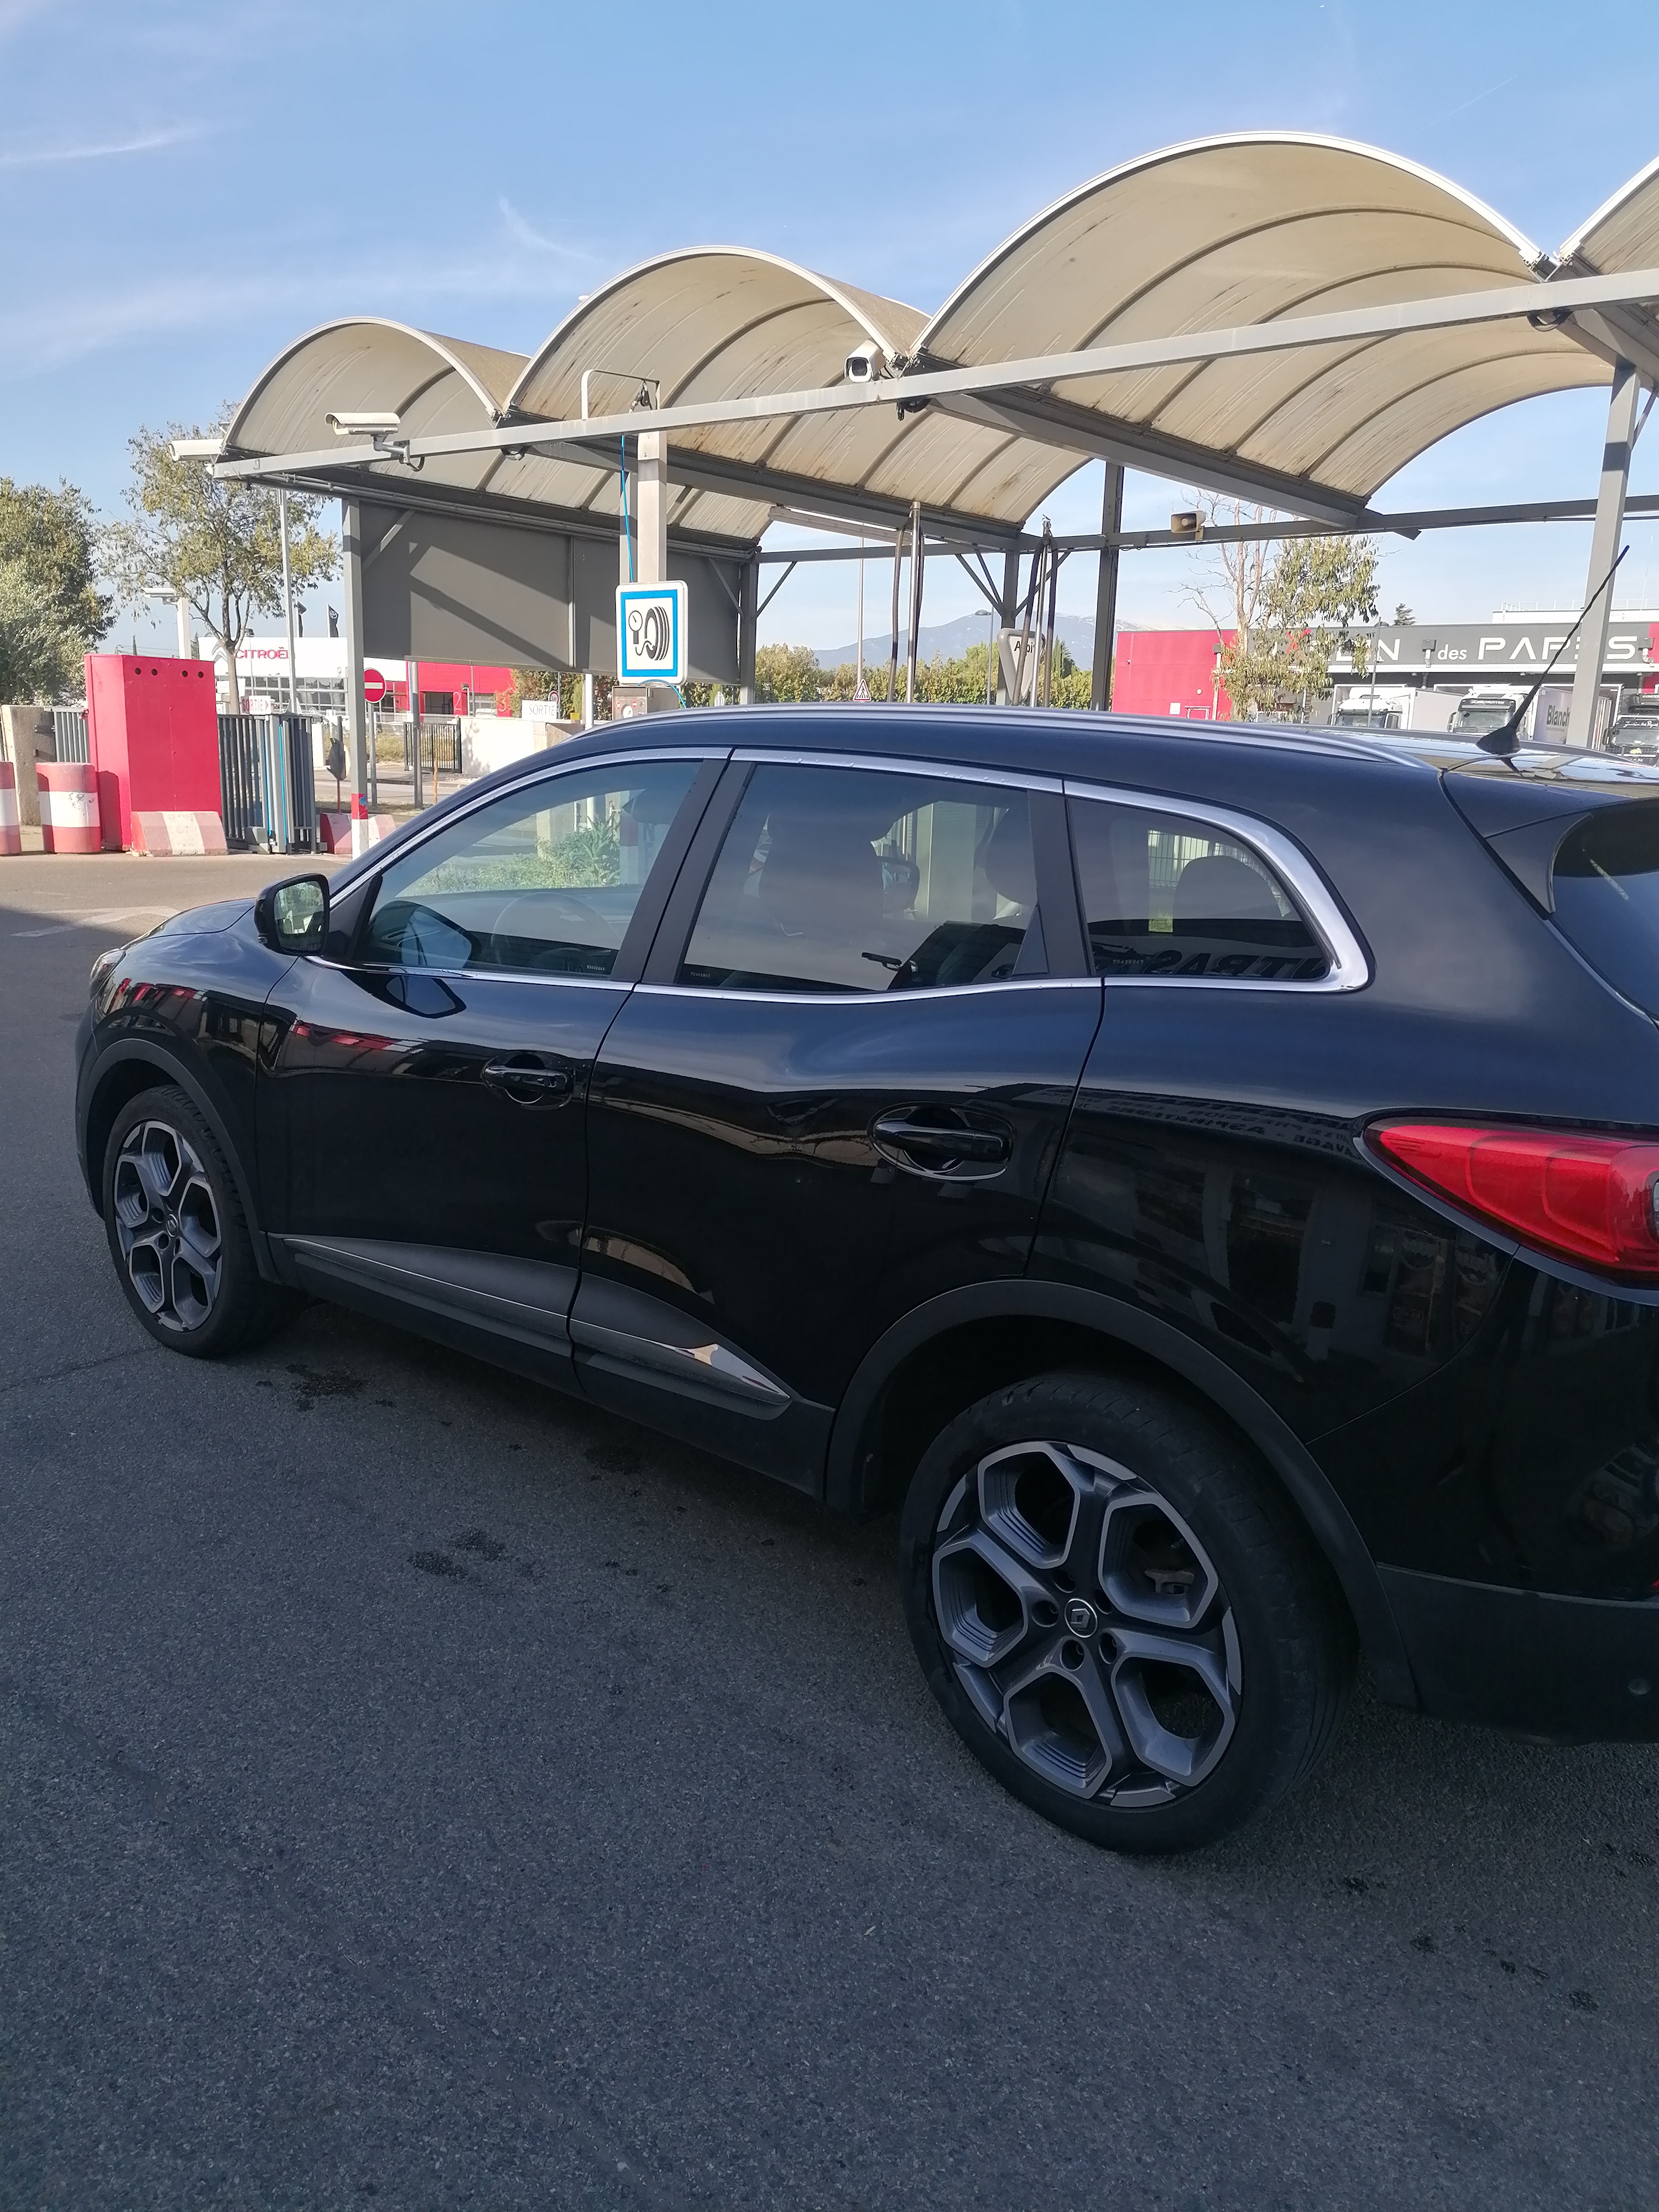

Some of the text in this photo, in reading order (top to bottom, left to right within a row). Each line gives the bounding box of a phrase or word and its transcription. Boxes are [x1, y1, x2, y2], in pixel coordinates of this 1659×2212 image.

[1437, 635, 1637, 660] des PAPS
[242, 698, 264, 711] SORTIE
[452, 691, 462, 711] 2
[529, 705, 555, 716] SORTIE
